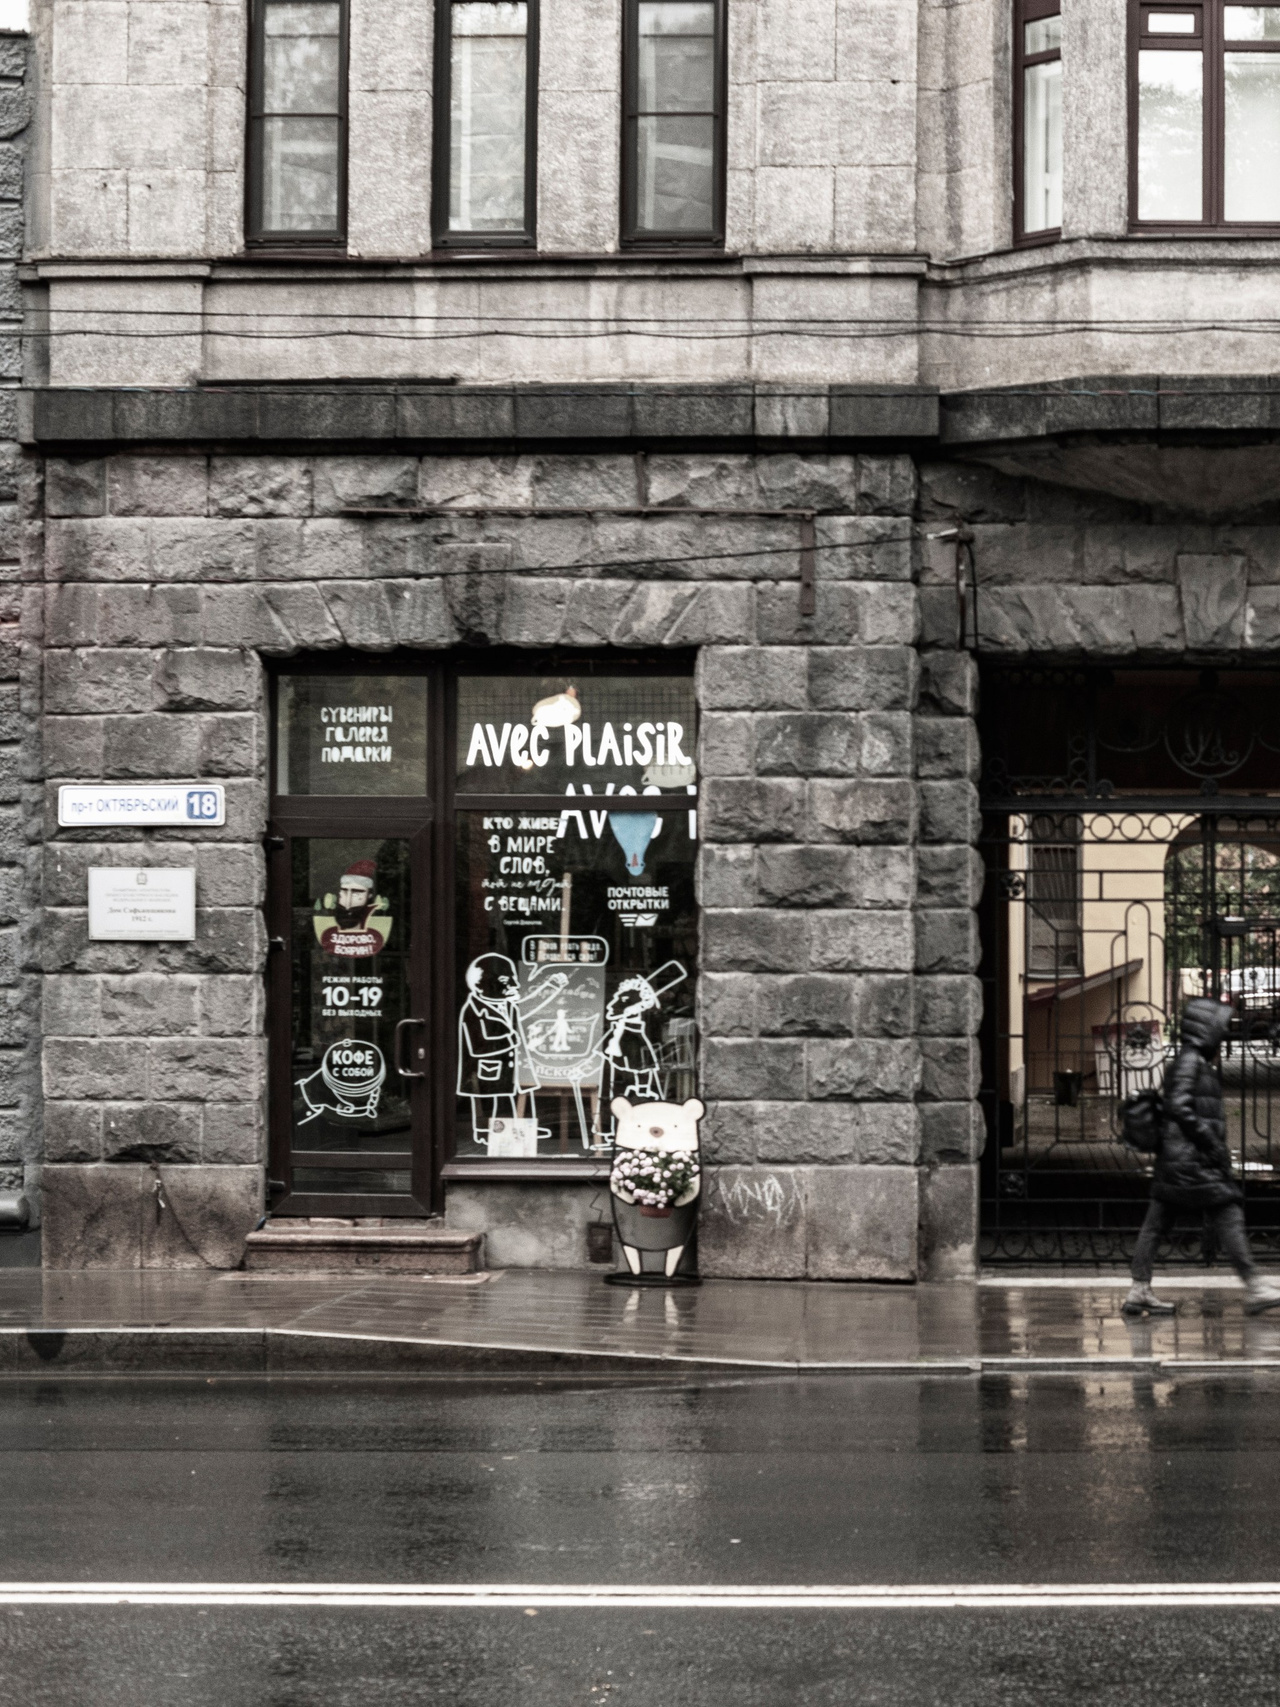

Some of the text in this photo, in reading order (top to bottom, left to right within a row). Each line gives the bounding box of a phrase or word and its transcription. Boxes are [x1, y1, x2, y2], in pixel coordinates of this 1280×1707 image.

[71, 793, 217, 816] пр-т ОКТЯБРЬСКИЙ 18
[482, 816, 514, 830] КТО
[487, 834, 557, 853] В МИРЕ
[607, 886, 669, 898] ПОЧТОВЫЕ
[484, 896, 495, 911] С
[607, 899, 669, 910] ОТКРЫТКИ
[352, 976, 383, 984] РАБОТЫ
[322, 986, 383, 1007] 10-19
[337, 1009, 383, 1017] ВЫХОДНЫХ
[332, 1049, 374, 1066] КОФЕ
[332, 1065, 374, 1077] С СОБОЙ
